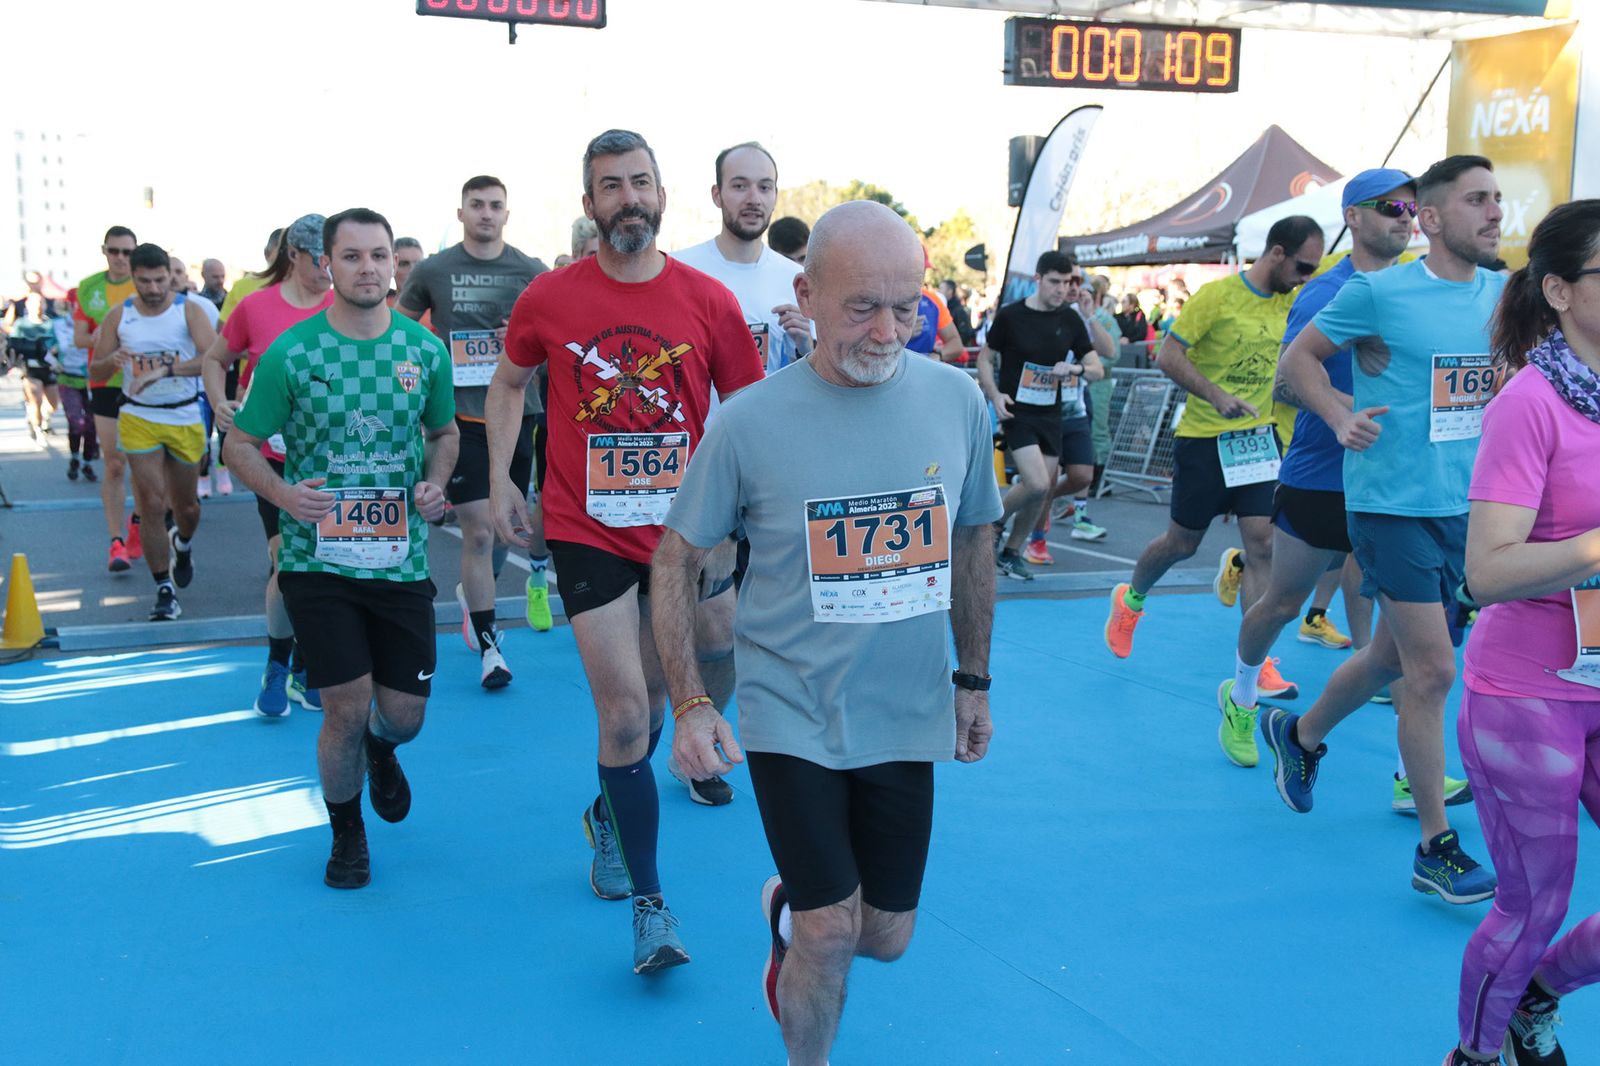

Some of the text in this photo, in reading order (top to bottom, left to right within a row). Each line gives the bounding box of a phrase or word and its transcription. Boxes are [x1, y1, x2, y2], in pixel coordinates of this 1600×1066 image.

[1469, 94, 1550, 139] NEXA
[602, 327, 614, 340] DE
[615, 325, 652, 338] AUSTRIA
[465, 340, 503, 356] 603
[1444, 364, 1504, 394] 169
[1225, 436, 1270, 456] 1393
[326, 461, 406, 475] Arabian Centres
[600, 448, 679, 477] 1564
[629, 478, 652, 486] JOSE
[848, 498, 869, 507] Medio
[870, 495, 898, 505] Maratón
[848, 502, 898, 514] Almería 2022
[328, 502, 400, 526] 1460
[826, 509, 933, 557] 1731
[865, 553, 901, 566] DIEGO
